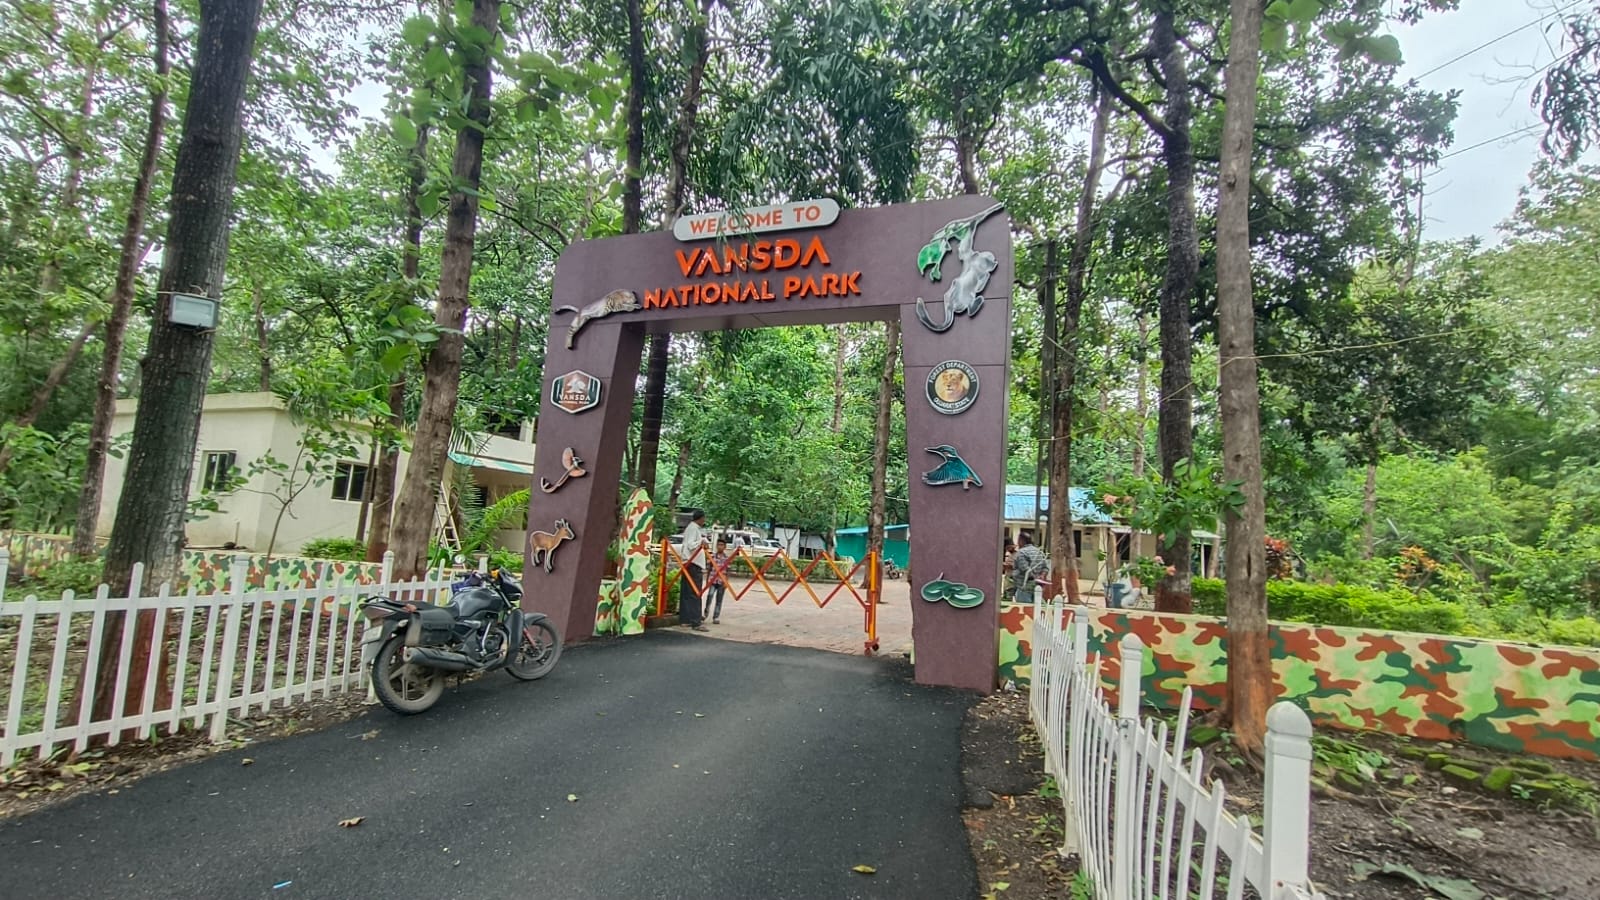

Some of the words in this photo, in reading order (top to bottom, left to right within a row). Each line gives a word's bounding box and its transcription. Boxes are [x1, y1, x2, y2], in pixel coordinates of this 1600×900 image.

[690, 210, 783, 234] WELCOME
[793, 206, 821, 223] TO
[675, 235, 831, 277] VANSDA
[643, 278, 776, 309] NATIONAL
[783, 271, 862, 299] PARK
[929, 364, 946, 383] FOREST
[945, 362, 977, 383] DEPARTMENT
